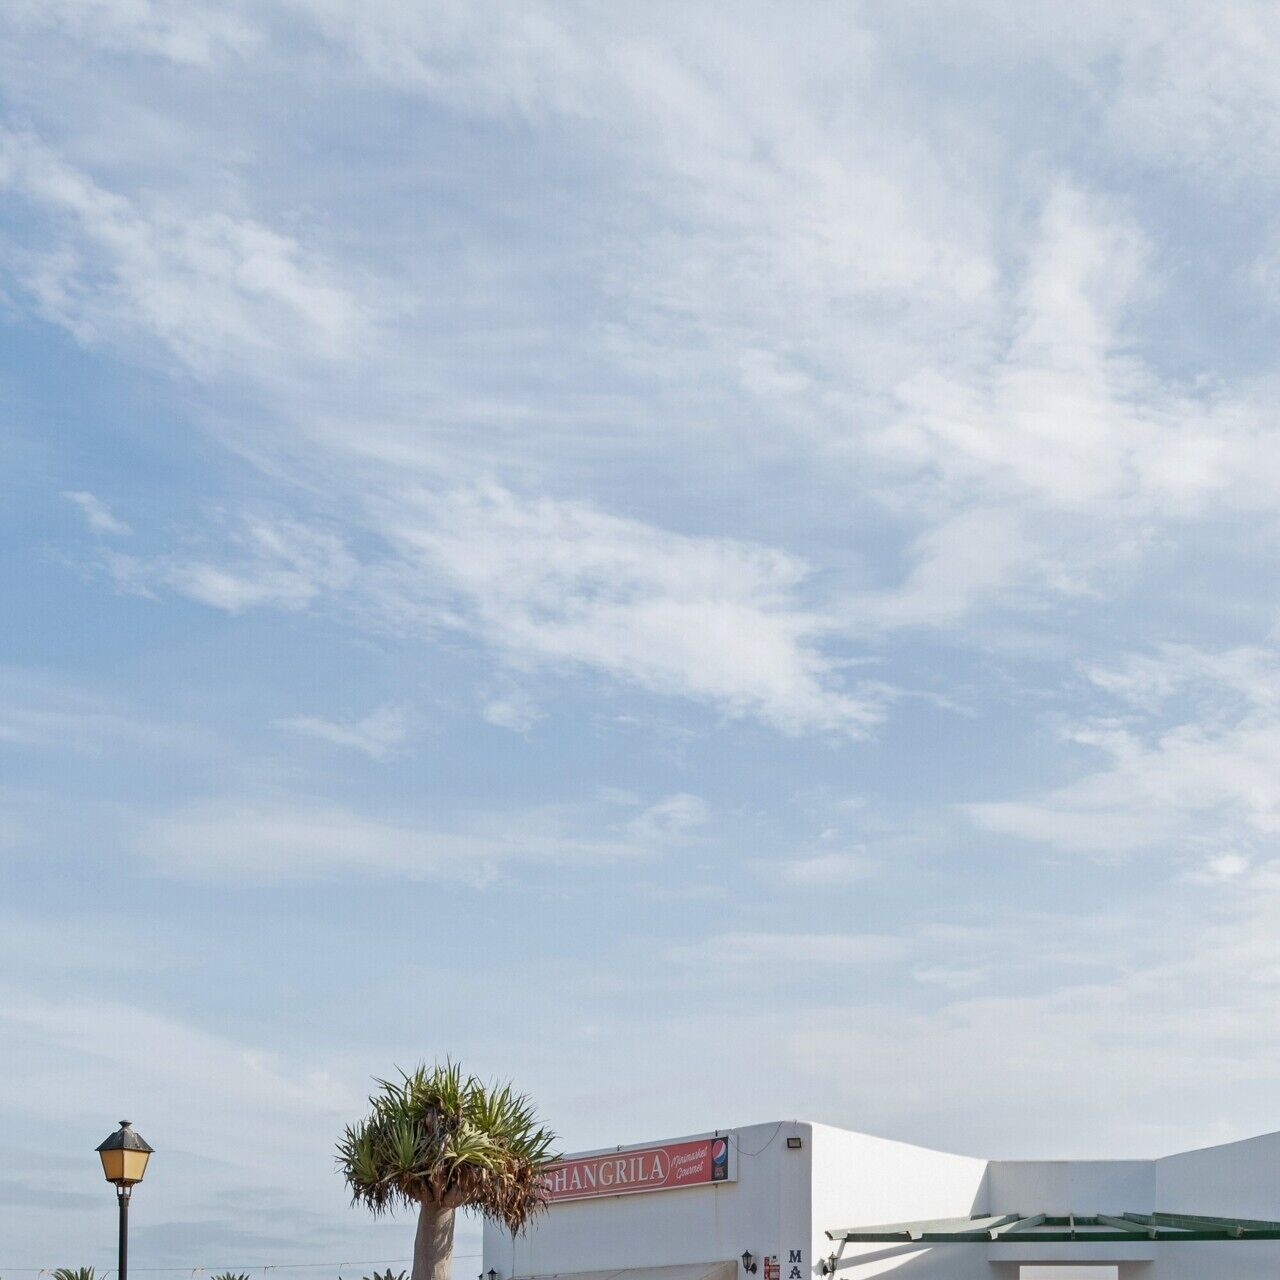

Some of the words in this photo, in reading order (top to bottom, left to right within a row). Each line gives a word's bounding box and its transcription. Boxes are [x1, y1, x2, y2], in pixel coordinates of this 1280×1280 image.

[670, 1146, 708, 1168] Minimarket
[542, 1154, 665, 1193] SHANGRILA
[676, 1161, 705, 1179] Gourmet
